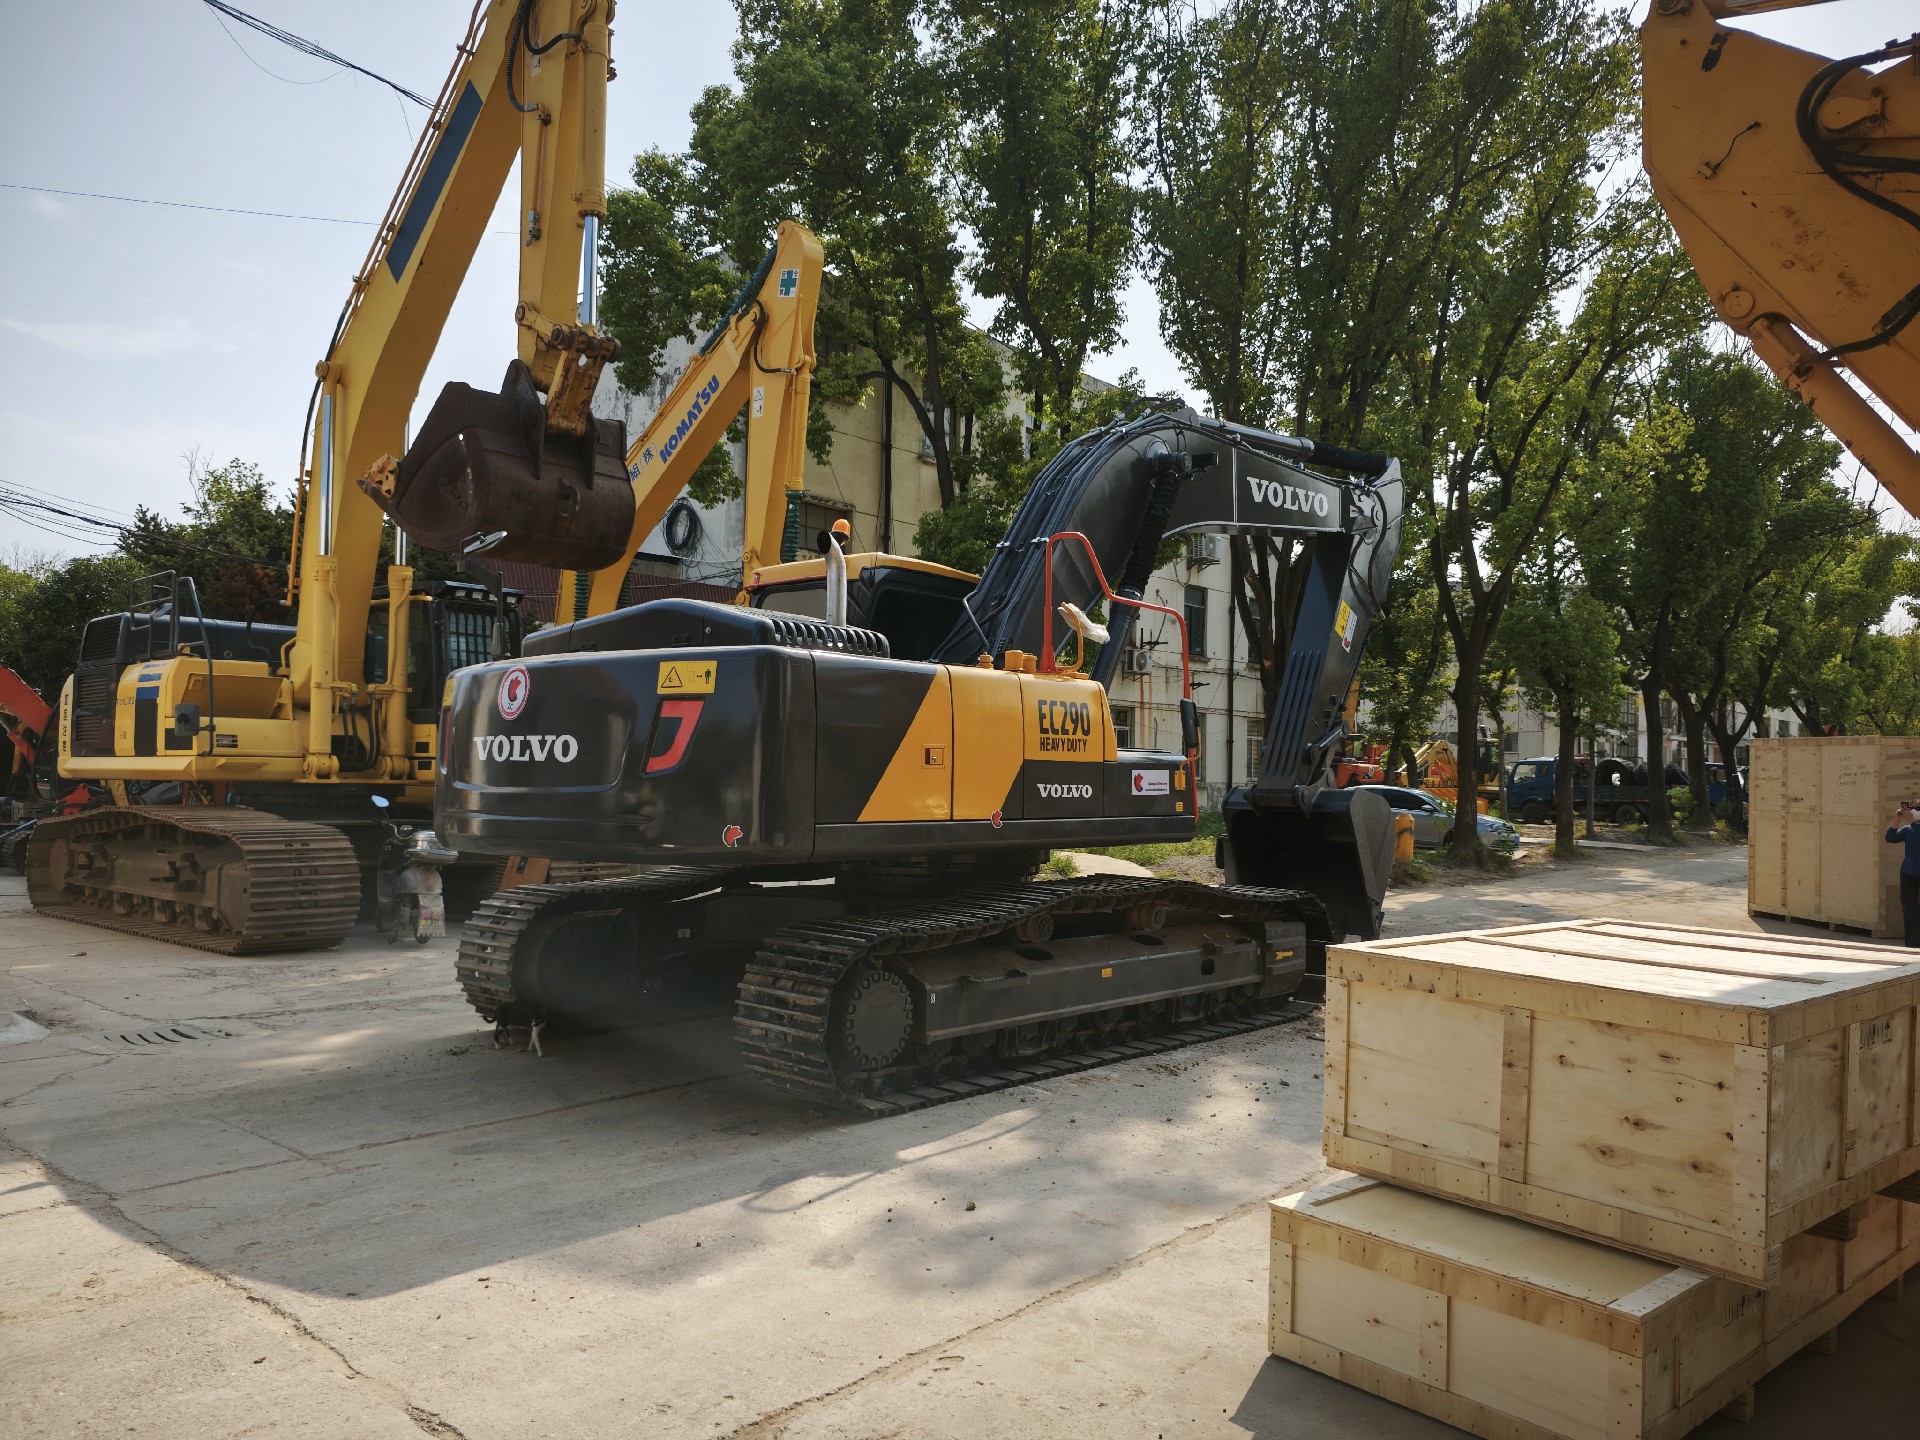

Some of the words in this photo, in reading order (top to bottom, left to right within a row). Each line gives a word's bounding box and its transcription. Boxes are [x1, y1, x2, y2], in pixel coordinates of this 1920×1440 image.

[659, 374, 720, 464] KOMATSU
[1246, 476, 1329, 517] VOLVO
[1038, 699, 1090, 736] EC290
[473, 734, 579, 763] VOLVO
[1036, 783, 1093, 798] VOLVO
